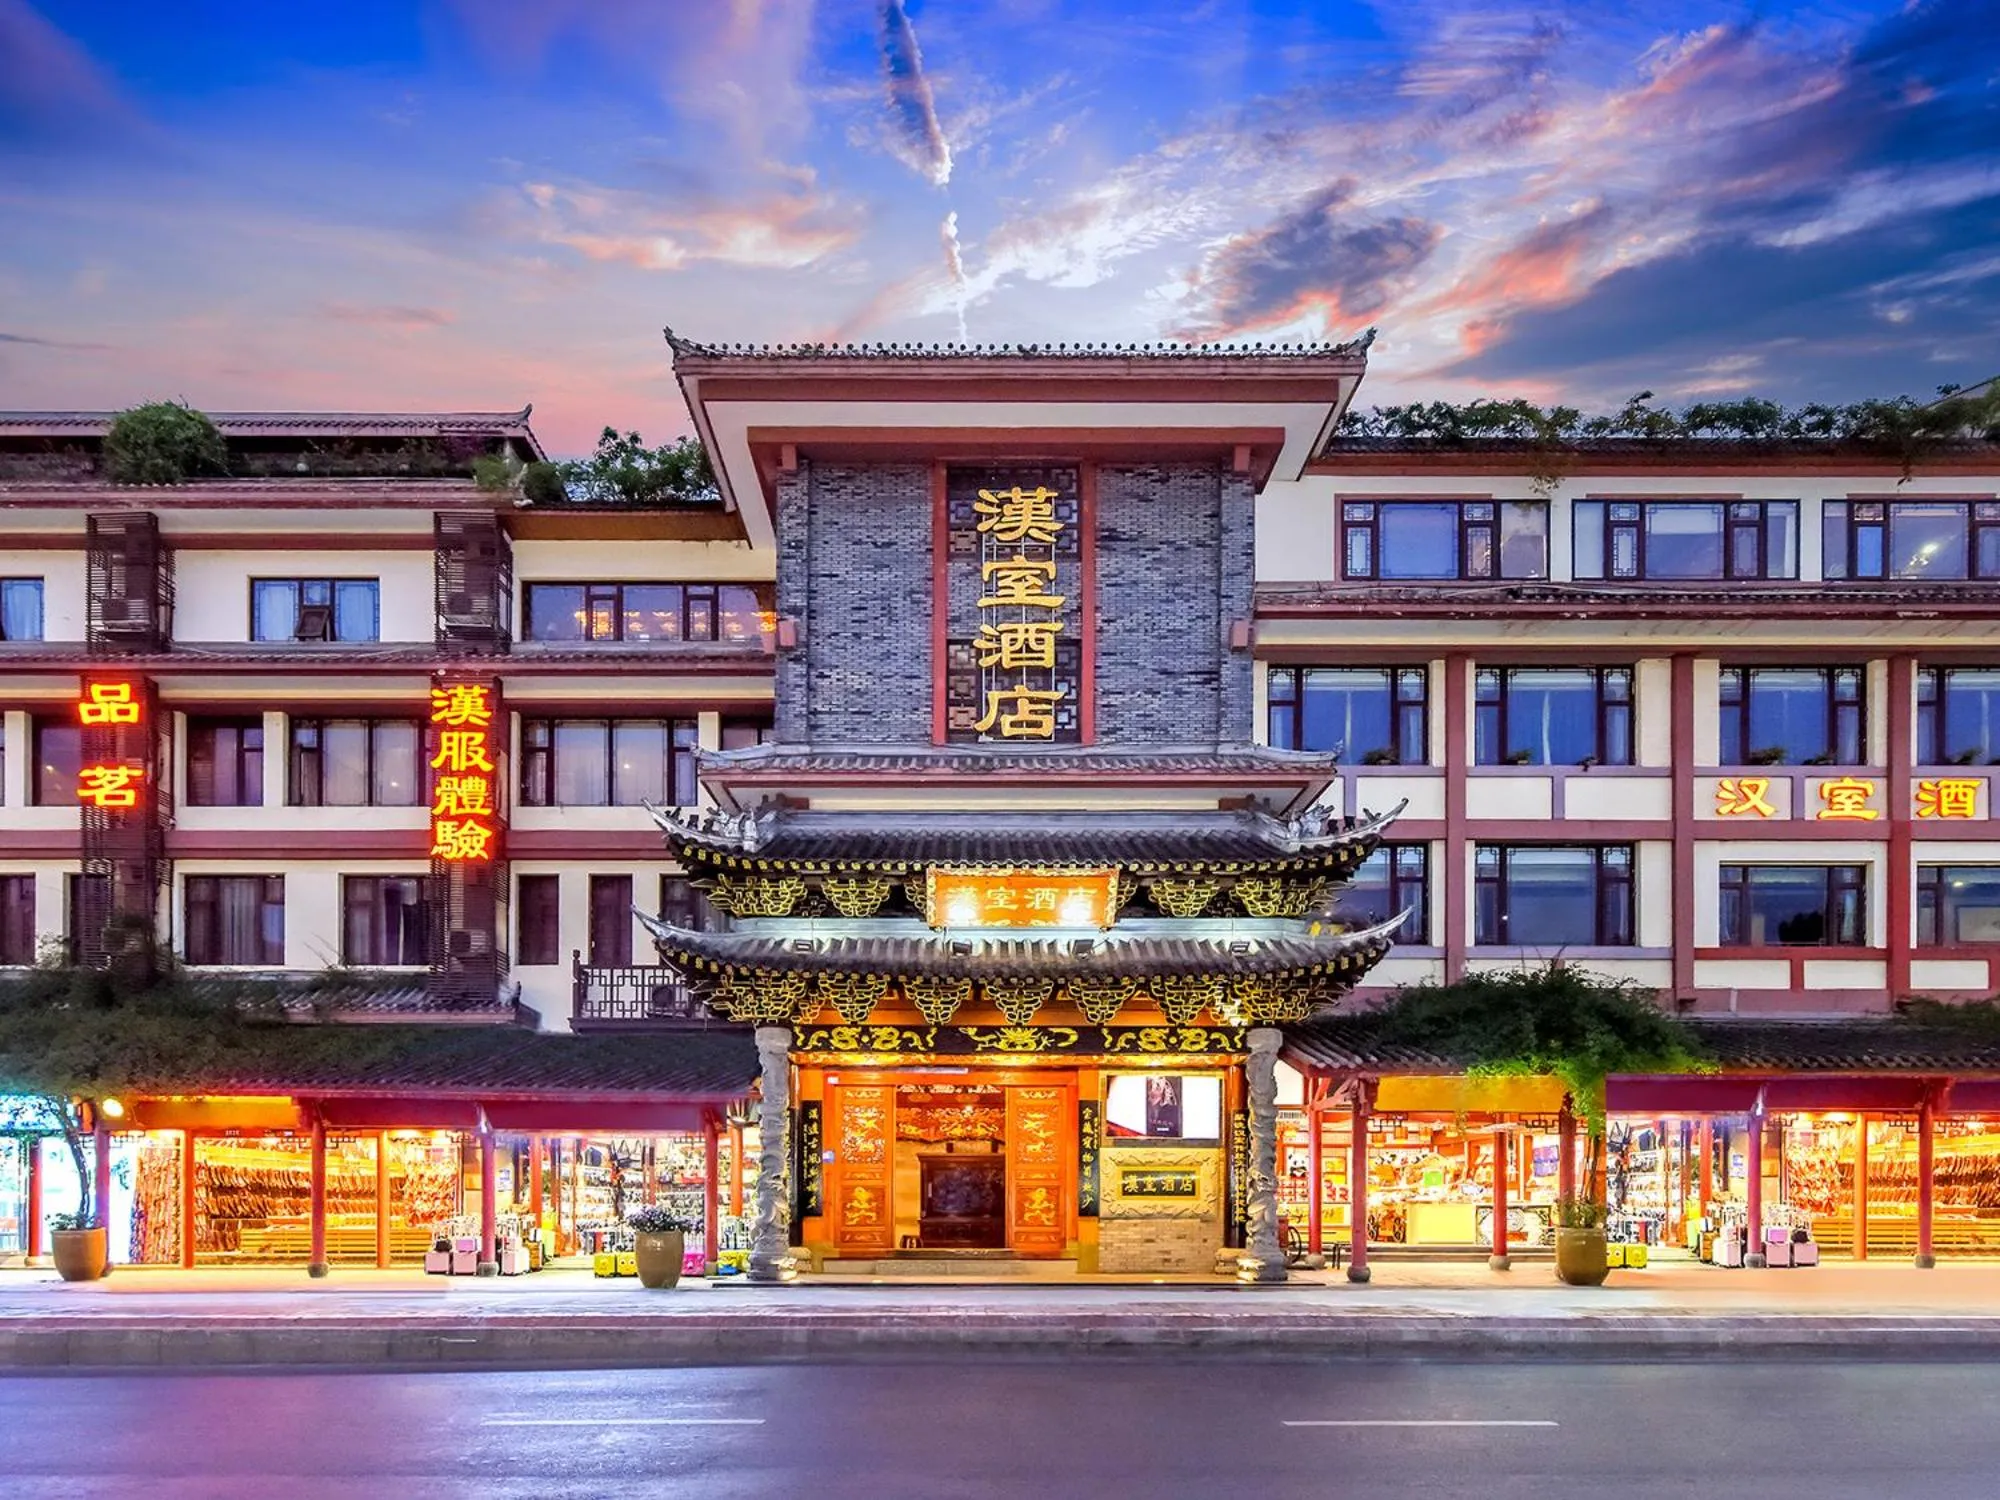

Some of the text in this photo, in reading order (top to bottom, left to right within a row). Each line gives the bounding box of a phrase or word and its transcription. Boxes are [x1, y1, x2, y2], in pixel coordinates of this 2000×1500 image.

[973, 487, 1066, 739] 漢室酒店
[77, 682, 143, 807] 品茗
[430, 685, 494, 860] 漢服體驗
[1716, 777, 1981, 821] 汉室酒
